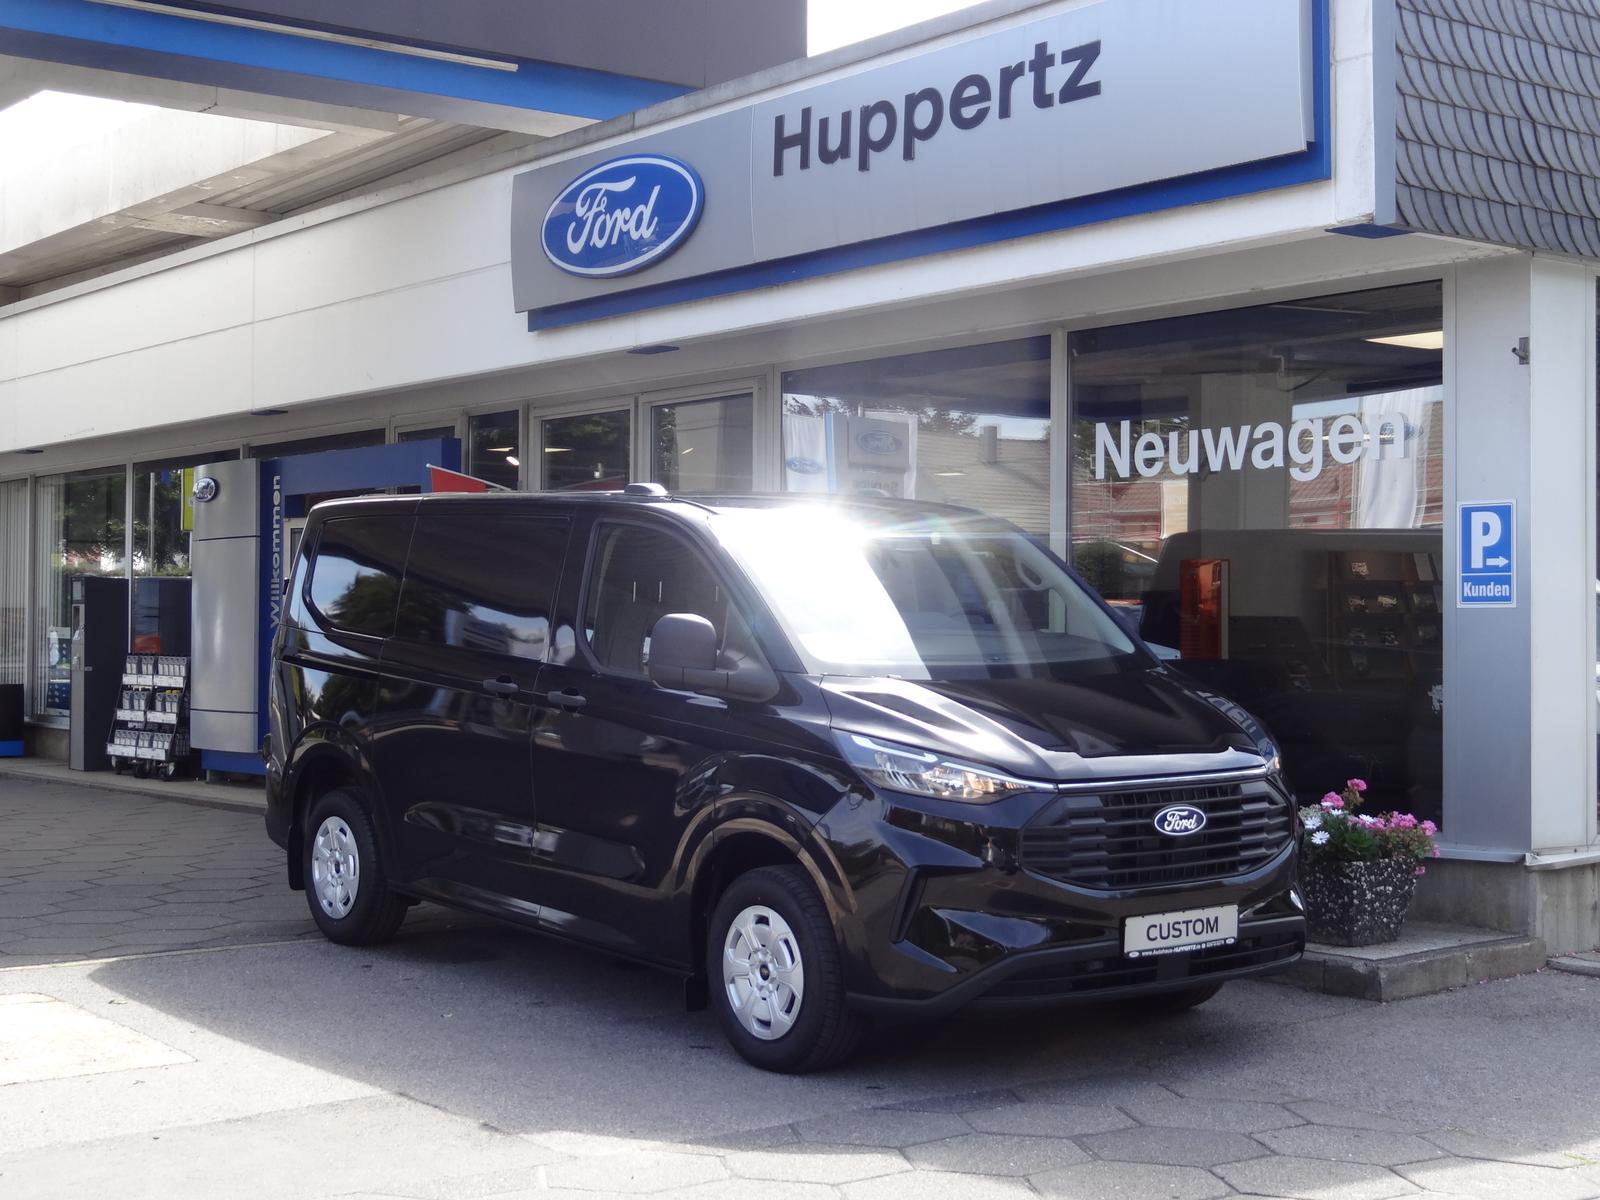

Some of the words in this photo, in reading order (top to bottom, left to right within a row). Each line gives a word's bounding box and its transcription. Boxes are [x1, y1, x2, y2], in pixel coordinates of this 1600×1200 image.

[773, 40, 1102, 177] Huppertz
[566, 175, 661, 255] Ford
[1094, 411, 1408, 481] Neuwagen
[270, 475, 281, 629] Willkommen
[1471, 511, 1502, 569] P
[1463, 581, 1510, 597] Kunden
[1164, 810, 1197, 831] Ford
[1146, 916, 1219, 942] CUSTOM
